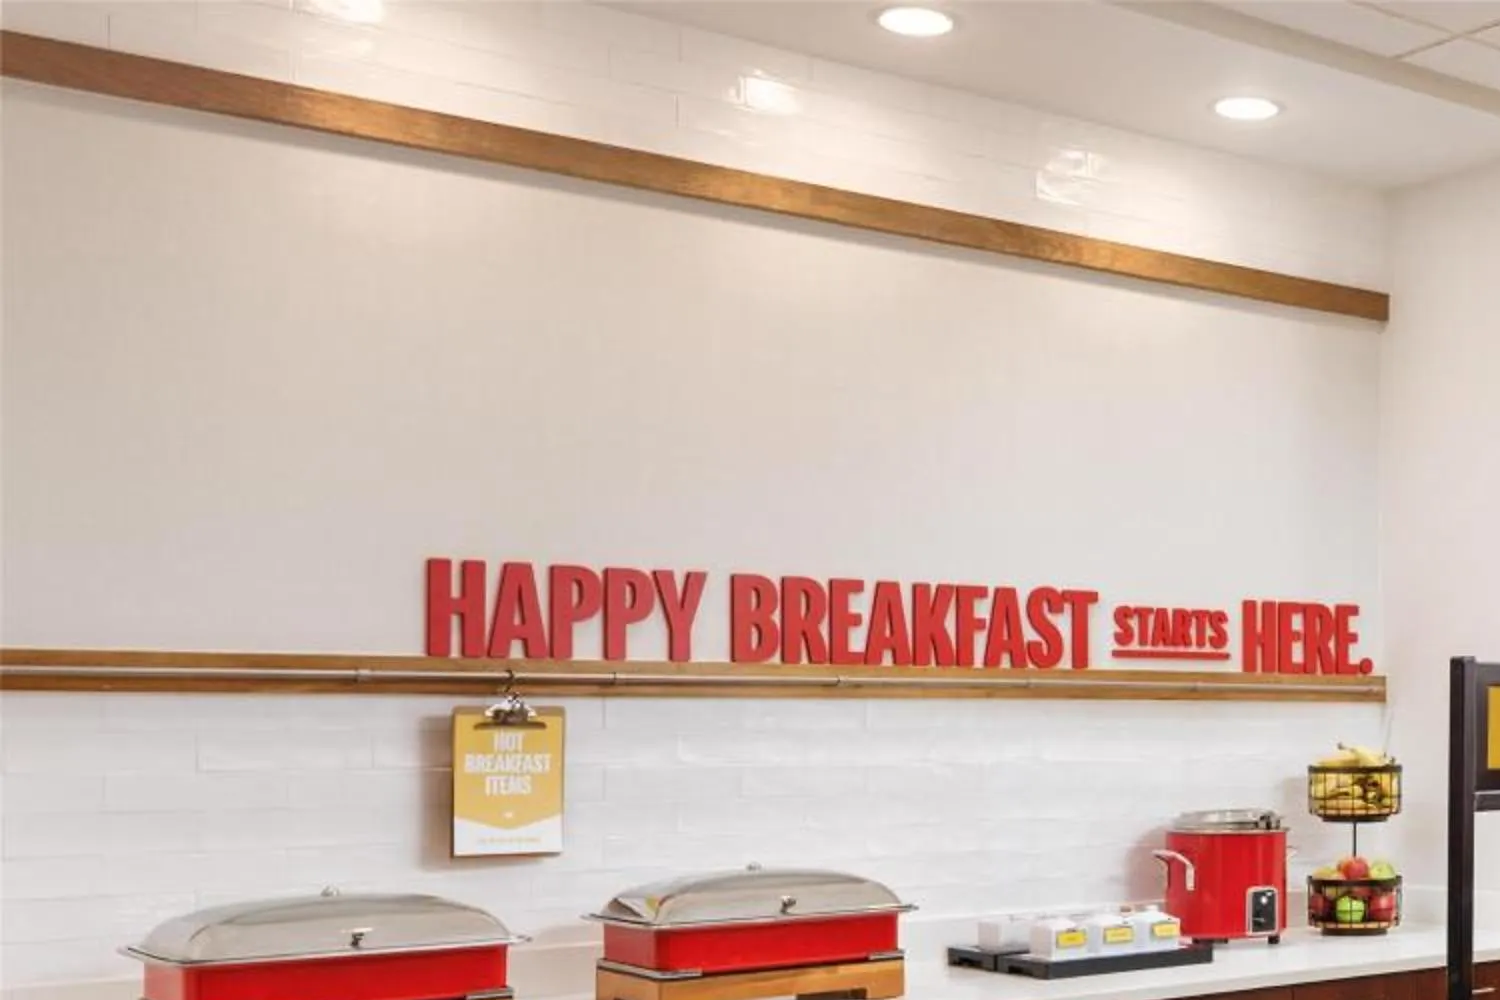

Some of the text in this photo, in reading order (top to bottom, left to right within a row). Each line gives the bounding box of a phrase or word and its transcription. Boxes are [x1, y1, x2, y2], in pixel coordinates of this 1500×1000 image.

[426, 557, 1374, 675] HAPPY BREAKFAST STARTS HERE.
[494, 731, 524, 751] HOT
[464, 752, 552, 774] BREAKFAST
[485, 774, 533, 797] ITEMS
